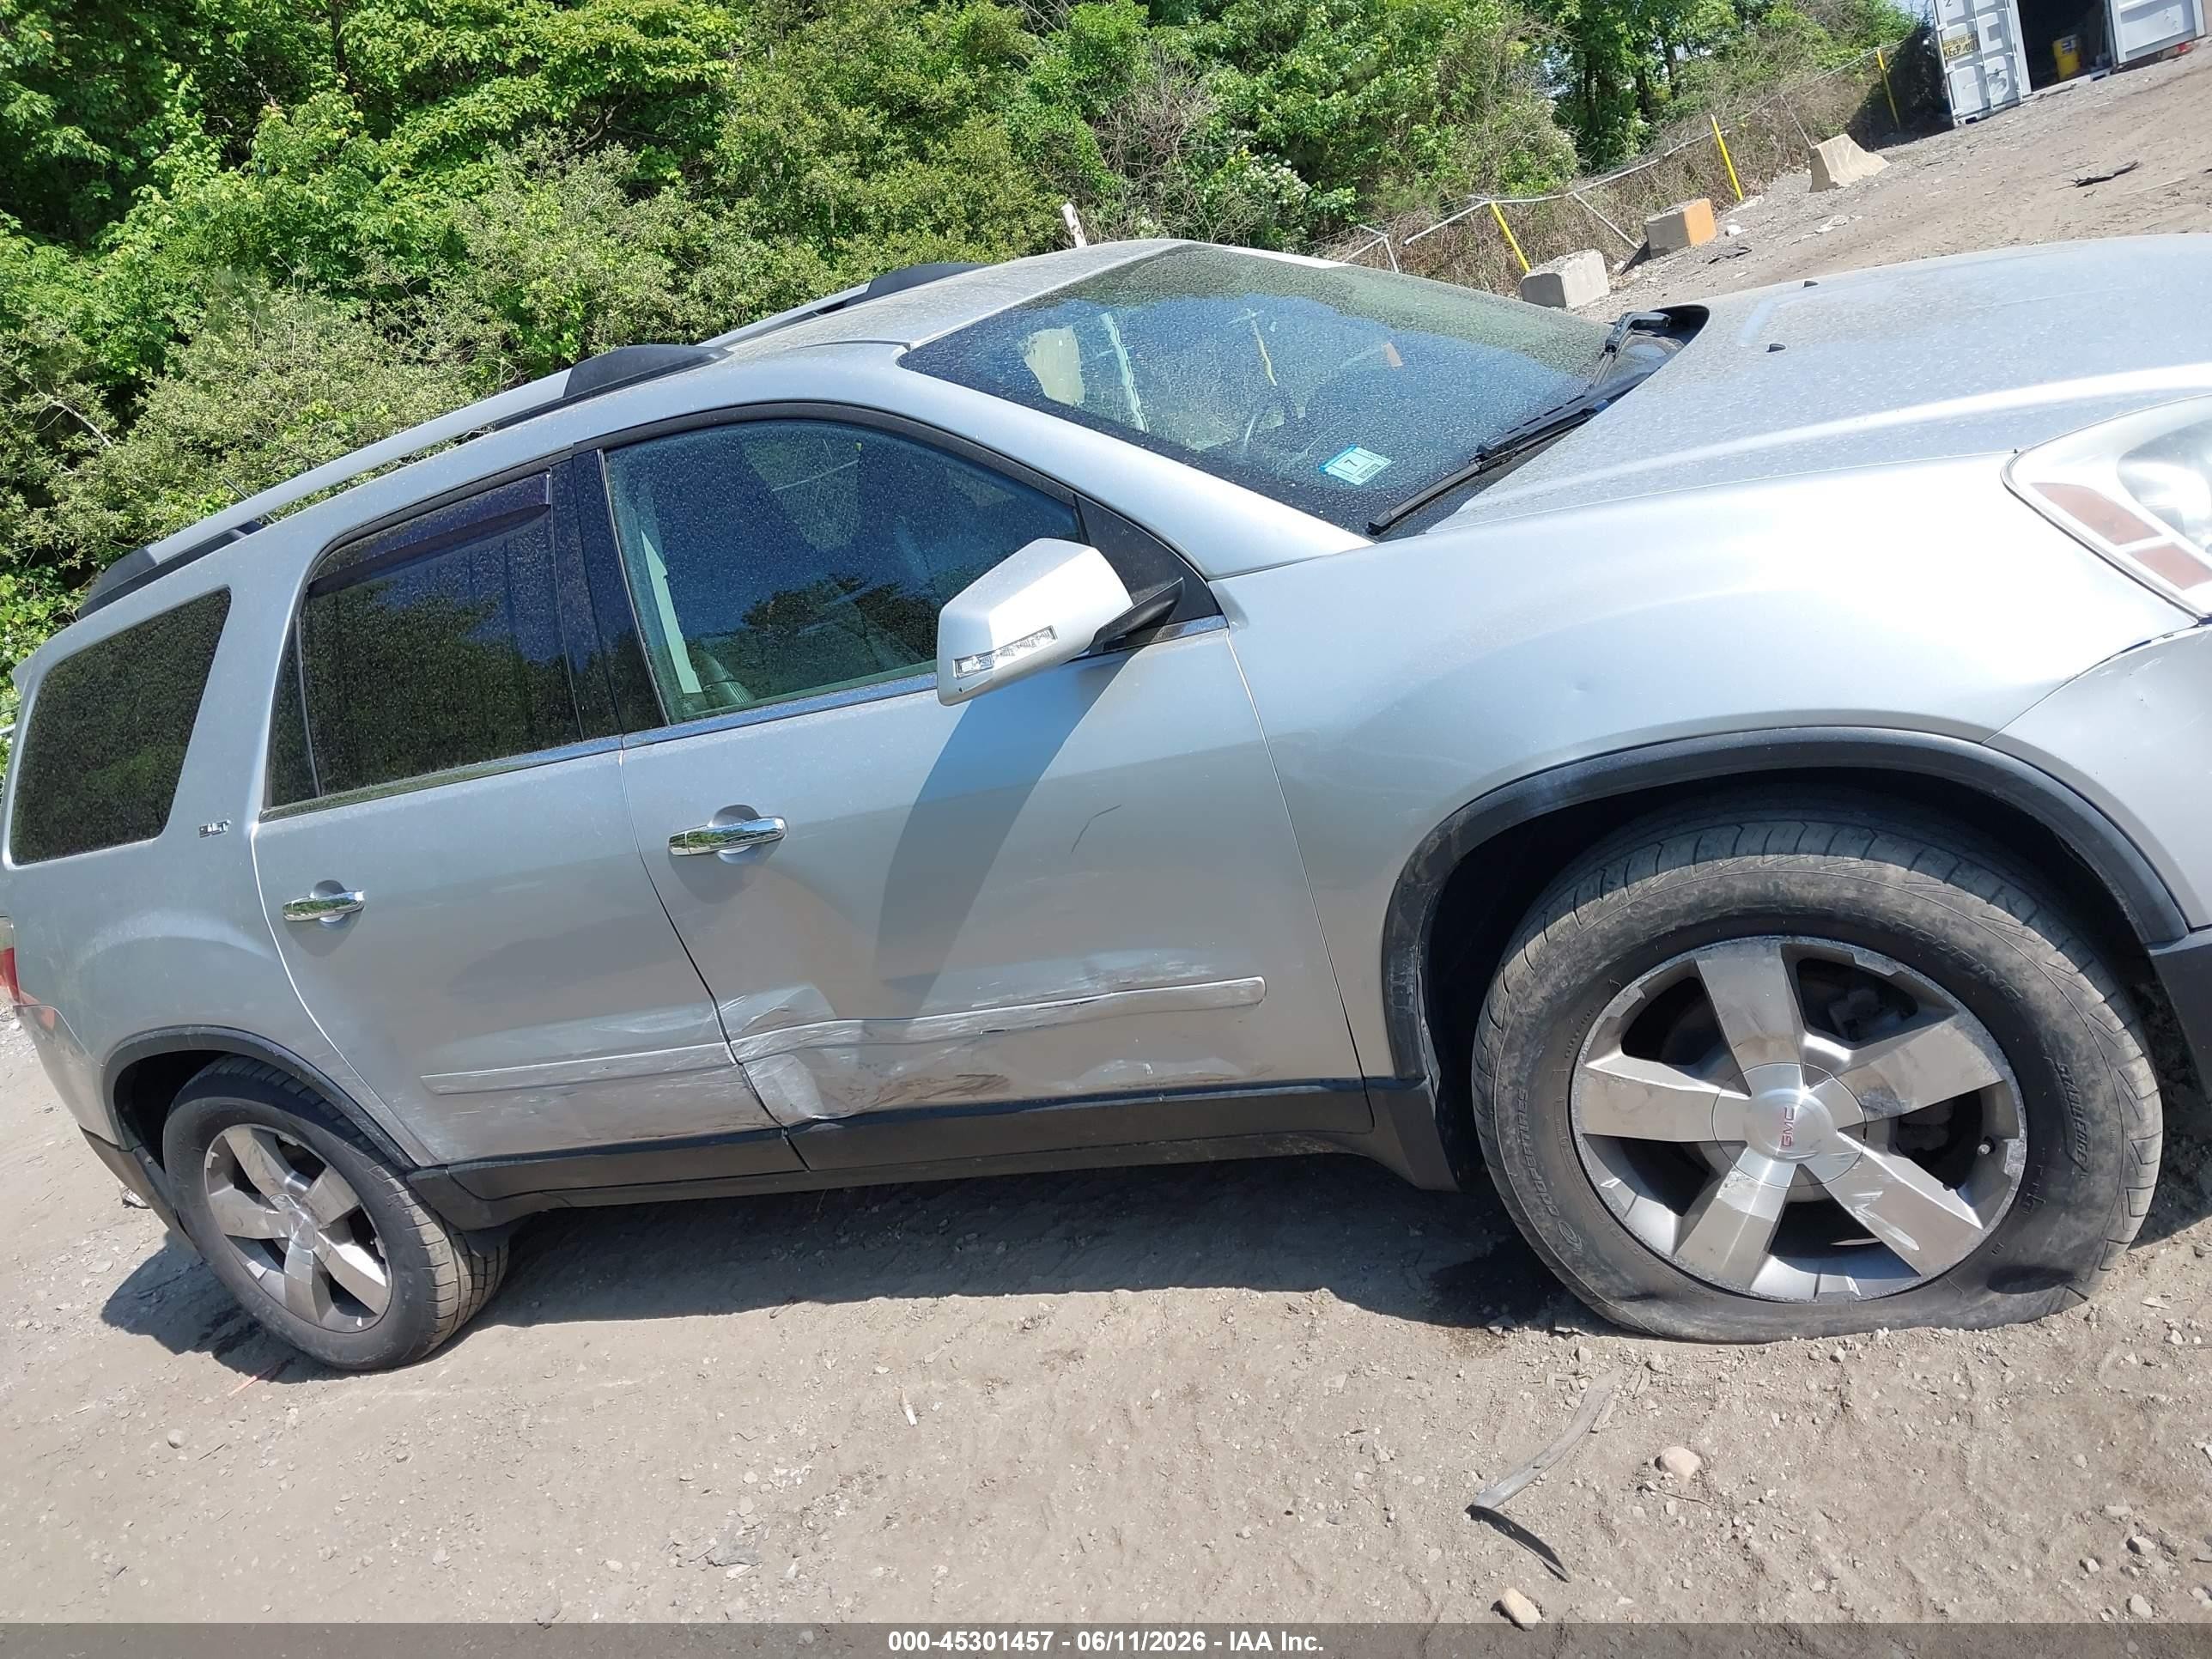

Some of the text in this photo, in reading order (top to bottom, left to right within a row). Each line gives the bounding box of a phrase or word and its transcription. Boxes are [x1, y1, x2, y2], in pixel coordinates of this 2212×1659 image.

[1343, 459, 1358, 467] 7
[199, 819, 232, 838] SLT
[1779, 1106, 1796, 1149] GMC
